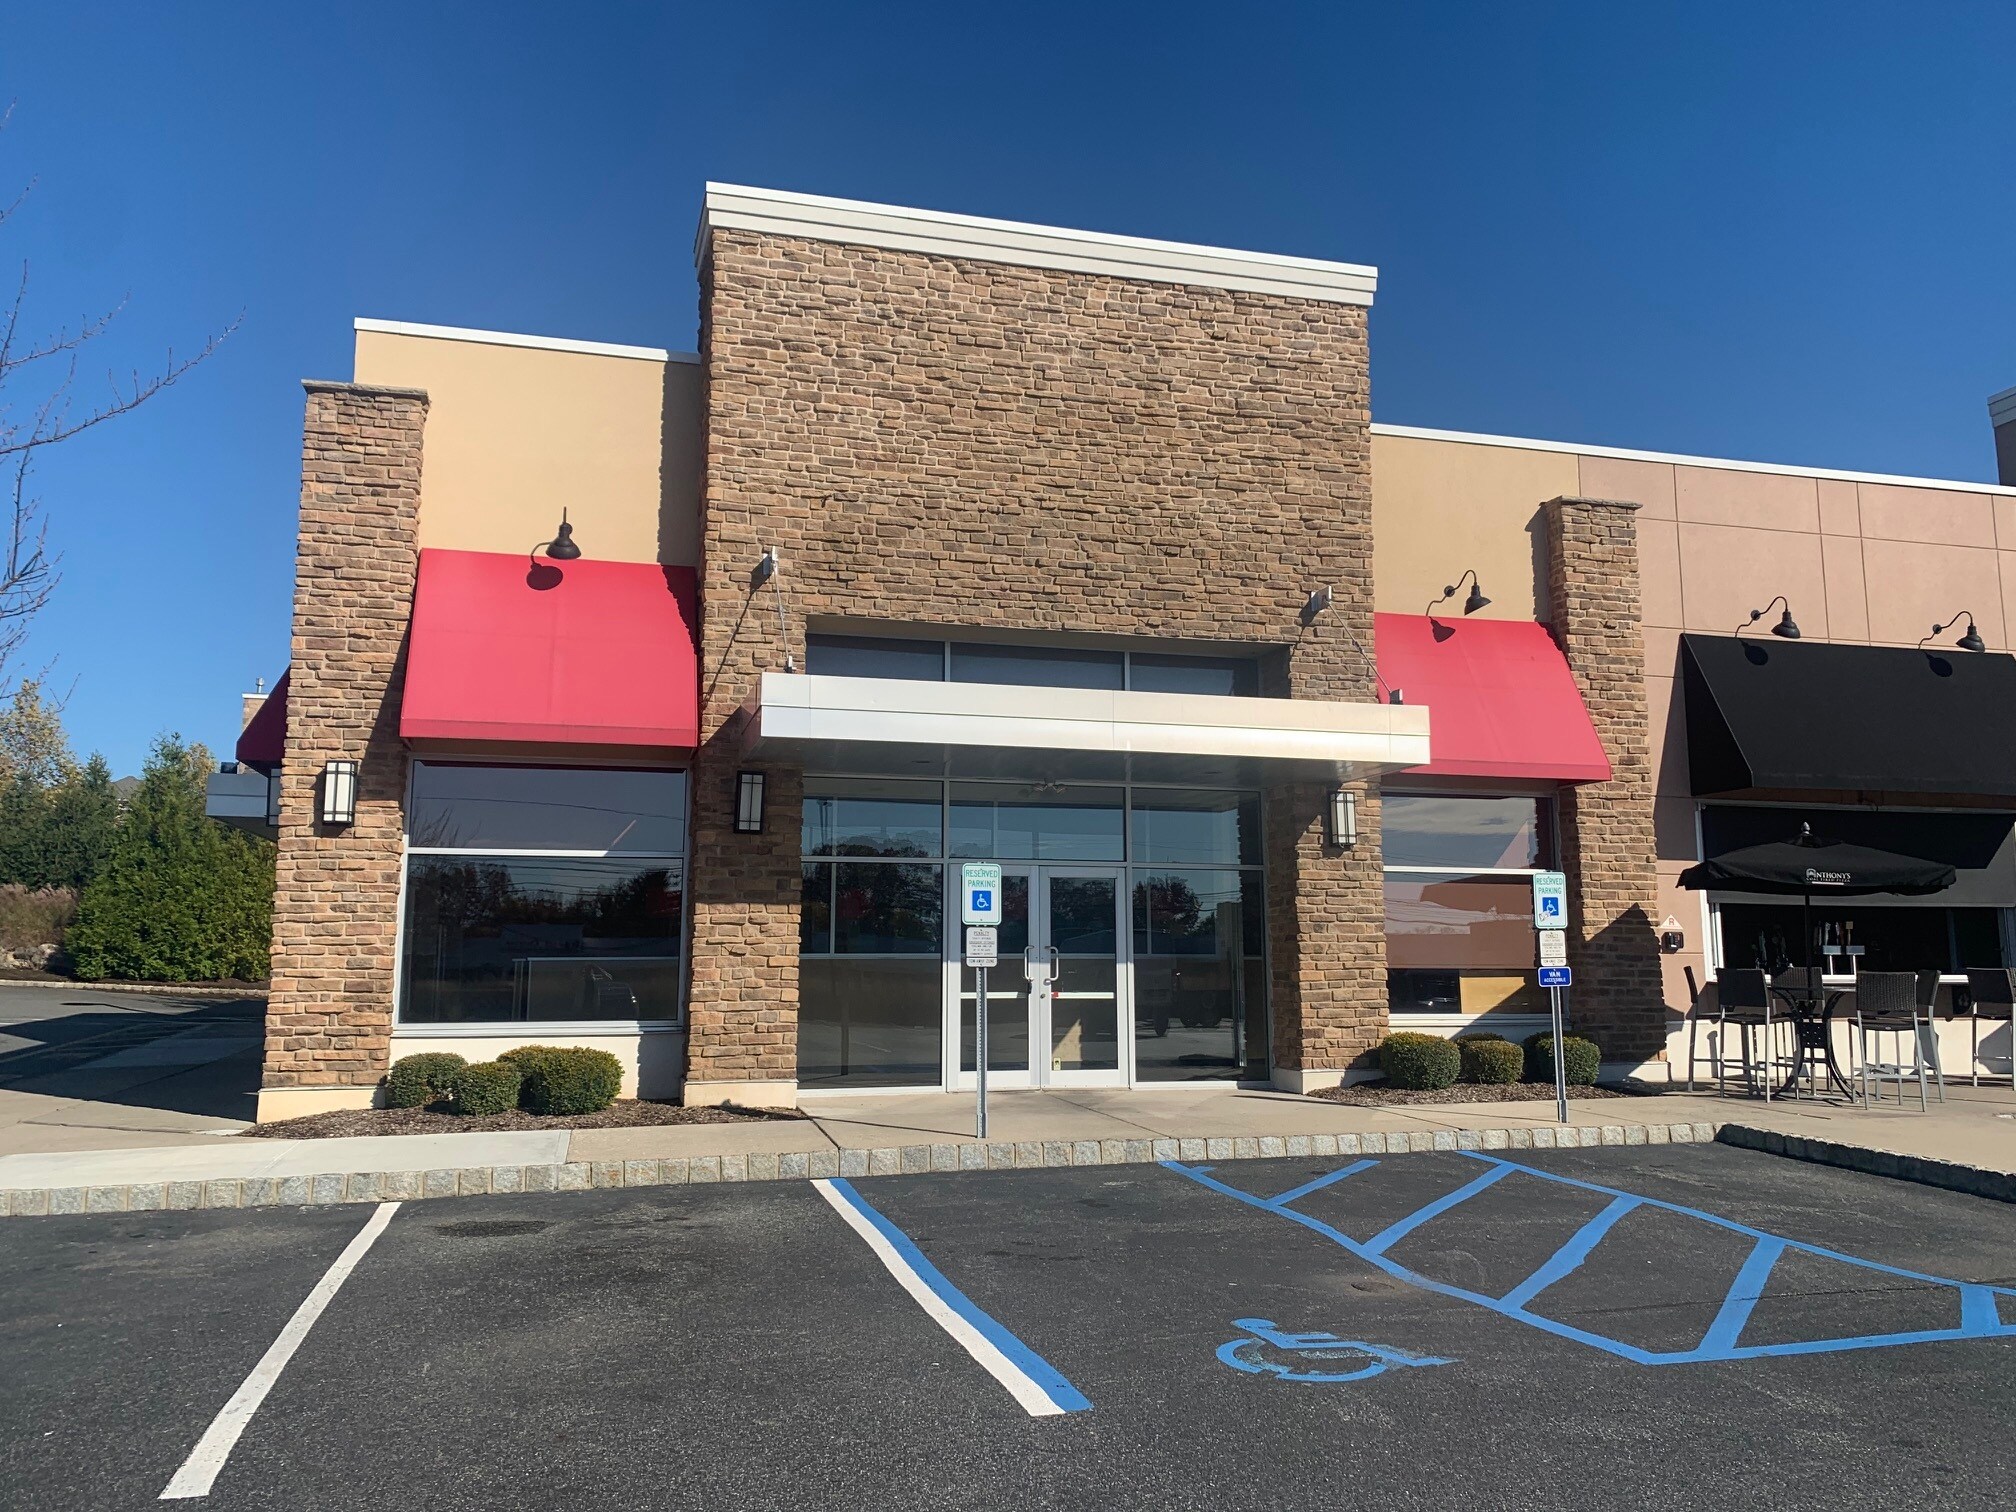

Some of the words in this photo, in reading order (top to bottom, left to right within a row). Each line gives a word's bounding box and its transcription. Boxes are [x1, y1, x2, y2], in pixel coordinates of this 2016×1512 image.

[966, 869, 998, 878] RESERVED
[968, 879, 996, 888] PARKING
[1538, 887, 1562, 895] PARKING
[1669, 917, 1675, 925] R
